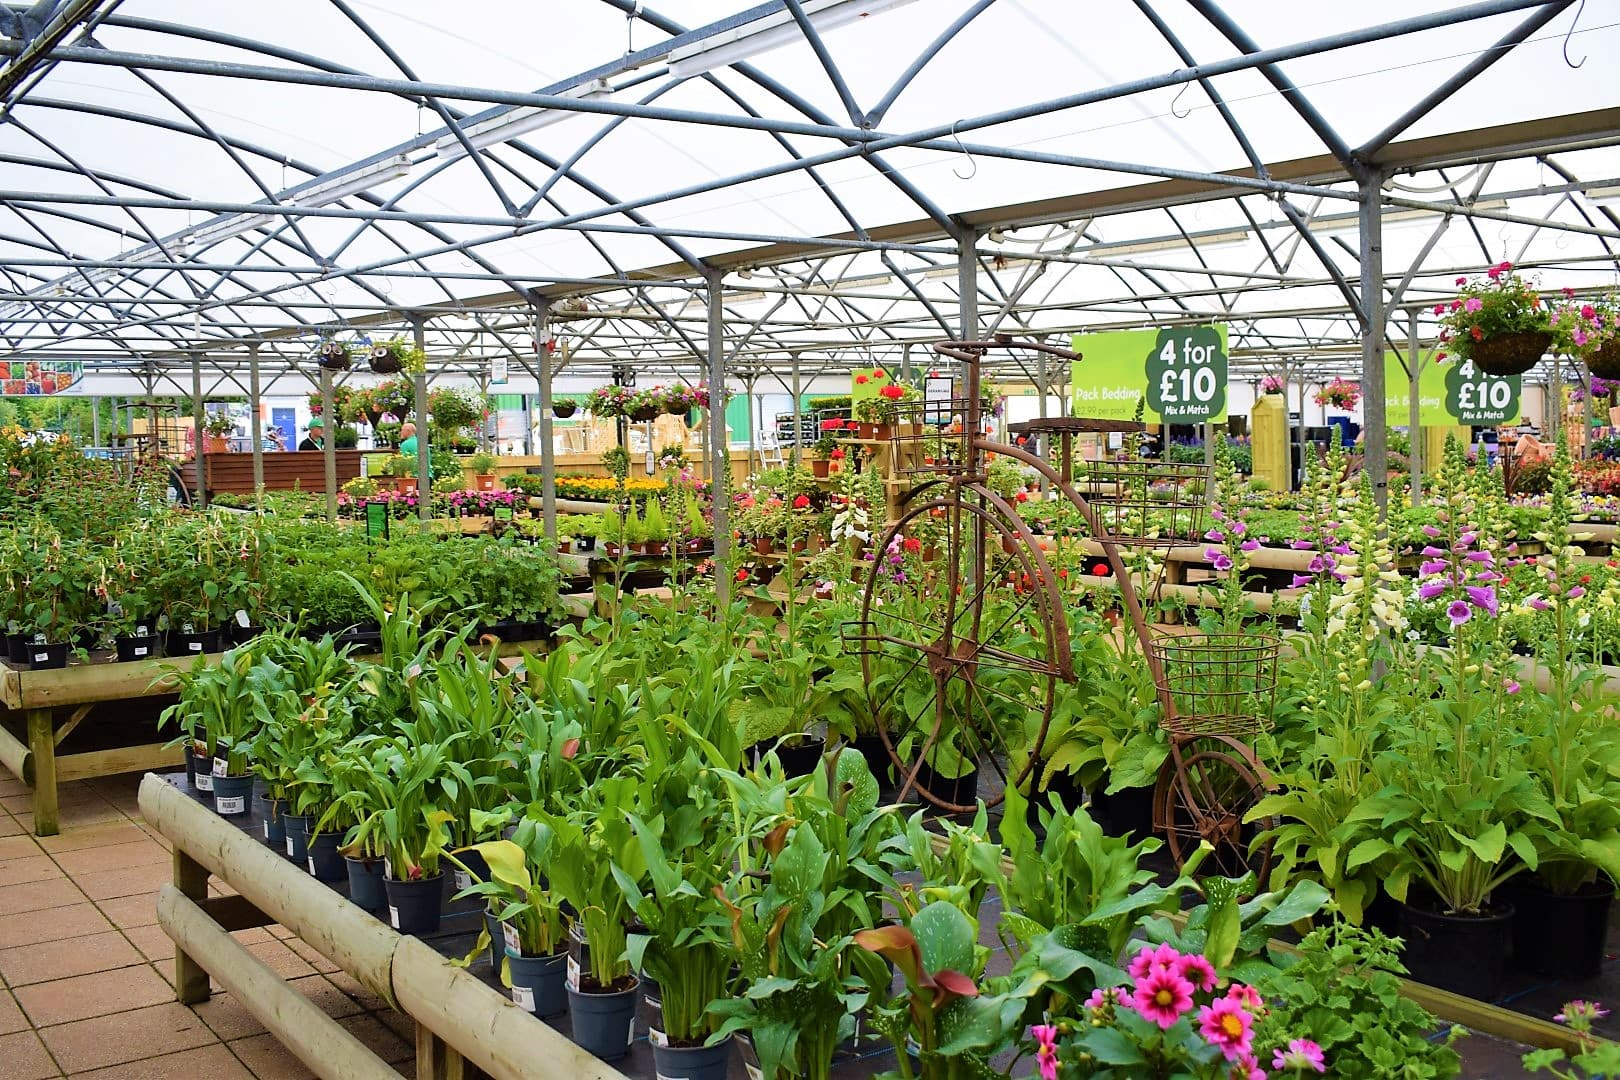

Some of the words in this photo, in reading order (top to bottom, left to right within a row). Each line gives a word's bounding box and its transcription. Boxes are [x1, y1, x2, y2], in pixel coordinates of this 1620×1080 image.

[1160, 339, 1176, 365] 4
[1183, 337, 1216, 365] for
[1458, 358, 1475, 380] 4
[1076, 387, 1098, 401] Pack
[1102, 386, 1141, 403] Bedding
[1160, 367, 1216, 402] £10
[1458, 380, 1511, 409] £10
[1164, 405, 1178, 416] Mix
[1178, 405, 1186, 415] &
[1186, 404, 1210, 415] Match
[1462, 410, 1475, 420] Mix
[1475, 410, 1483, 420] &
[1483, 410, 1505, 420] Match
